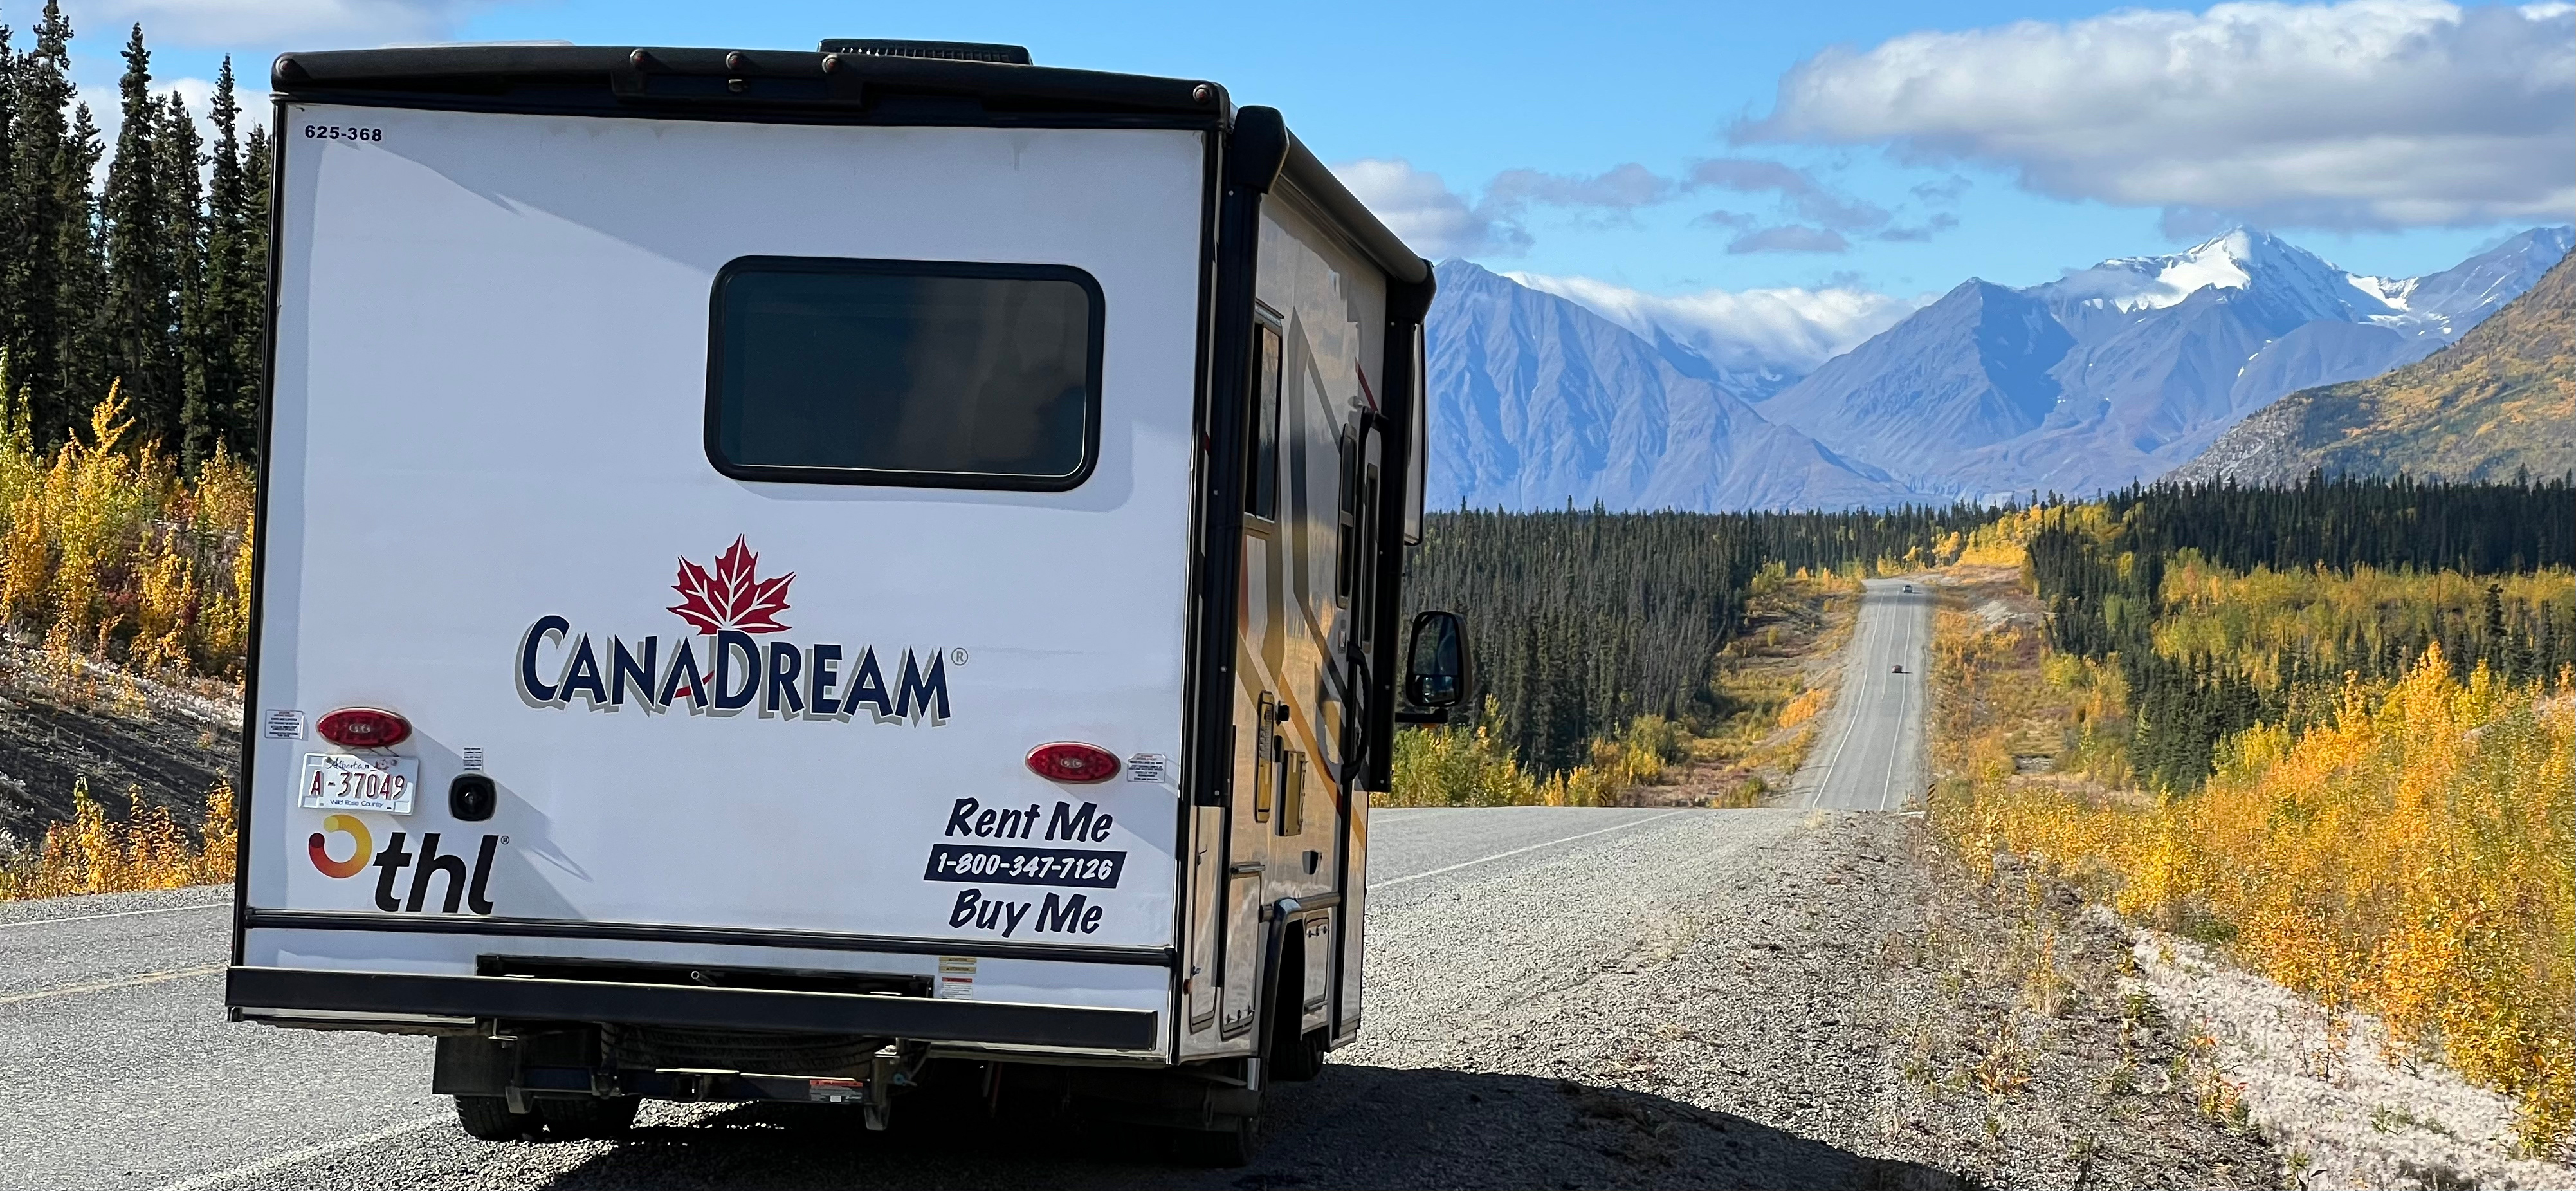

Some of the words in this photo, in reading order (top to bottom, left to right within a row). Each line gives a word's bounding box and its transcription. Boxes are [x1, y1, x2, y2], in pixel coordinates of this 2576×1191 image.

[305, 125, 382, 142] 625-368
[326, 757, 364, 769] Alberta
[309, 770, 406, 800] A-37049
[944, 797, 1041, 839] Rent
[1045, 800, 1113, 843] Me
[937, 852, 1113, 880] 1-800-347-7126
[949, 888, 1032, 939] Buy
[1034, 892, 1104, 934] Me
